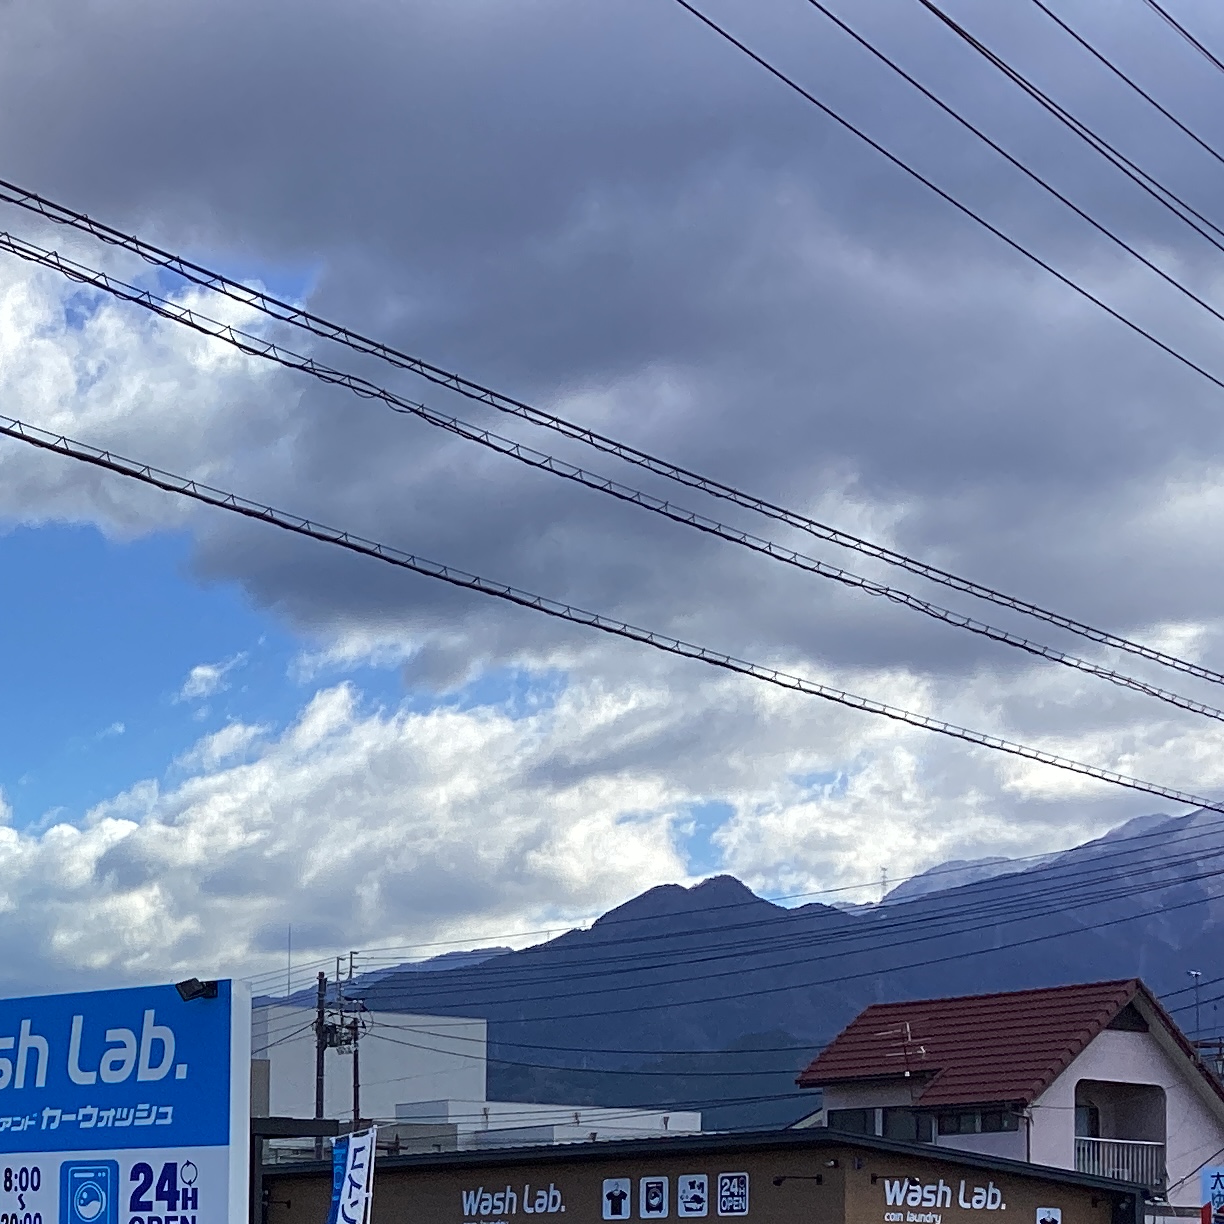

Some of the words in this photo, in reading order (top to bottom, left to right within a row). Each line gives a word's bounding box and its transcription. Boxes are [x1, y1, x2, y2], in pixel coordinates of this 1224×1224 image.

[67, 1008, 188, 1085] Lab.
[3, 1166, 41, 1192] 8:00
[129, 1162, 199, 1212] 24H
[884, 1178, 952, 1208] Wash
[958, 1180, 1007, 1210] Lab.
[462, 1185, 517, 1216] Wash
[523, 1183, 566, 1214] Lab.
[721, 1196, 746, 1211] OPEN
[884, 1212, 904, 1222] coin
